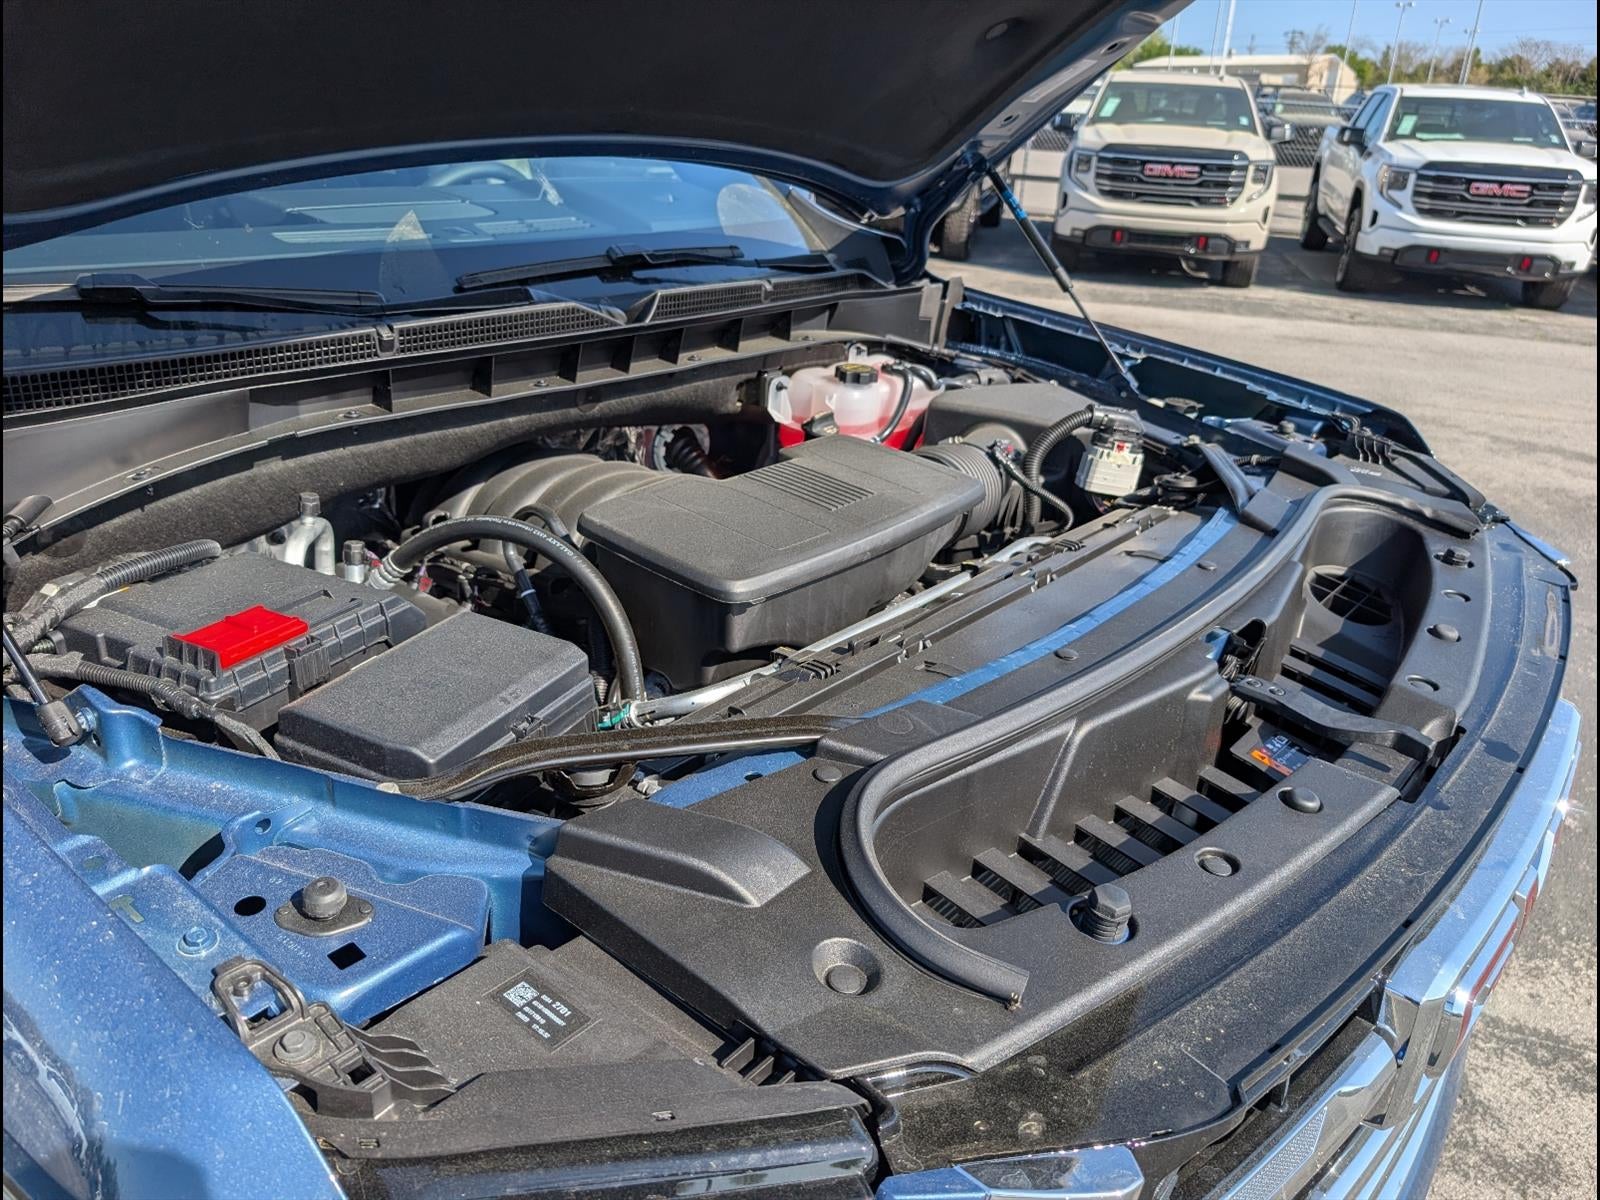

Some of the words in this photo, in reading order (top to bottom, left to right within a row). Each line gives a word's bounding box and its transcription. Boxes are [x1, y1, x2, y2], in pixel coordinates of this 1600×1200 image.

[1143, 163, 1200, 178] GMC
[1469, 182, 1532, 198] GMC
[546, 537, 574, 557] GALAXY
[551, 1001, 572, 1017] 2701
